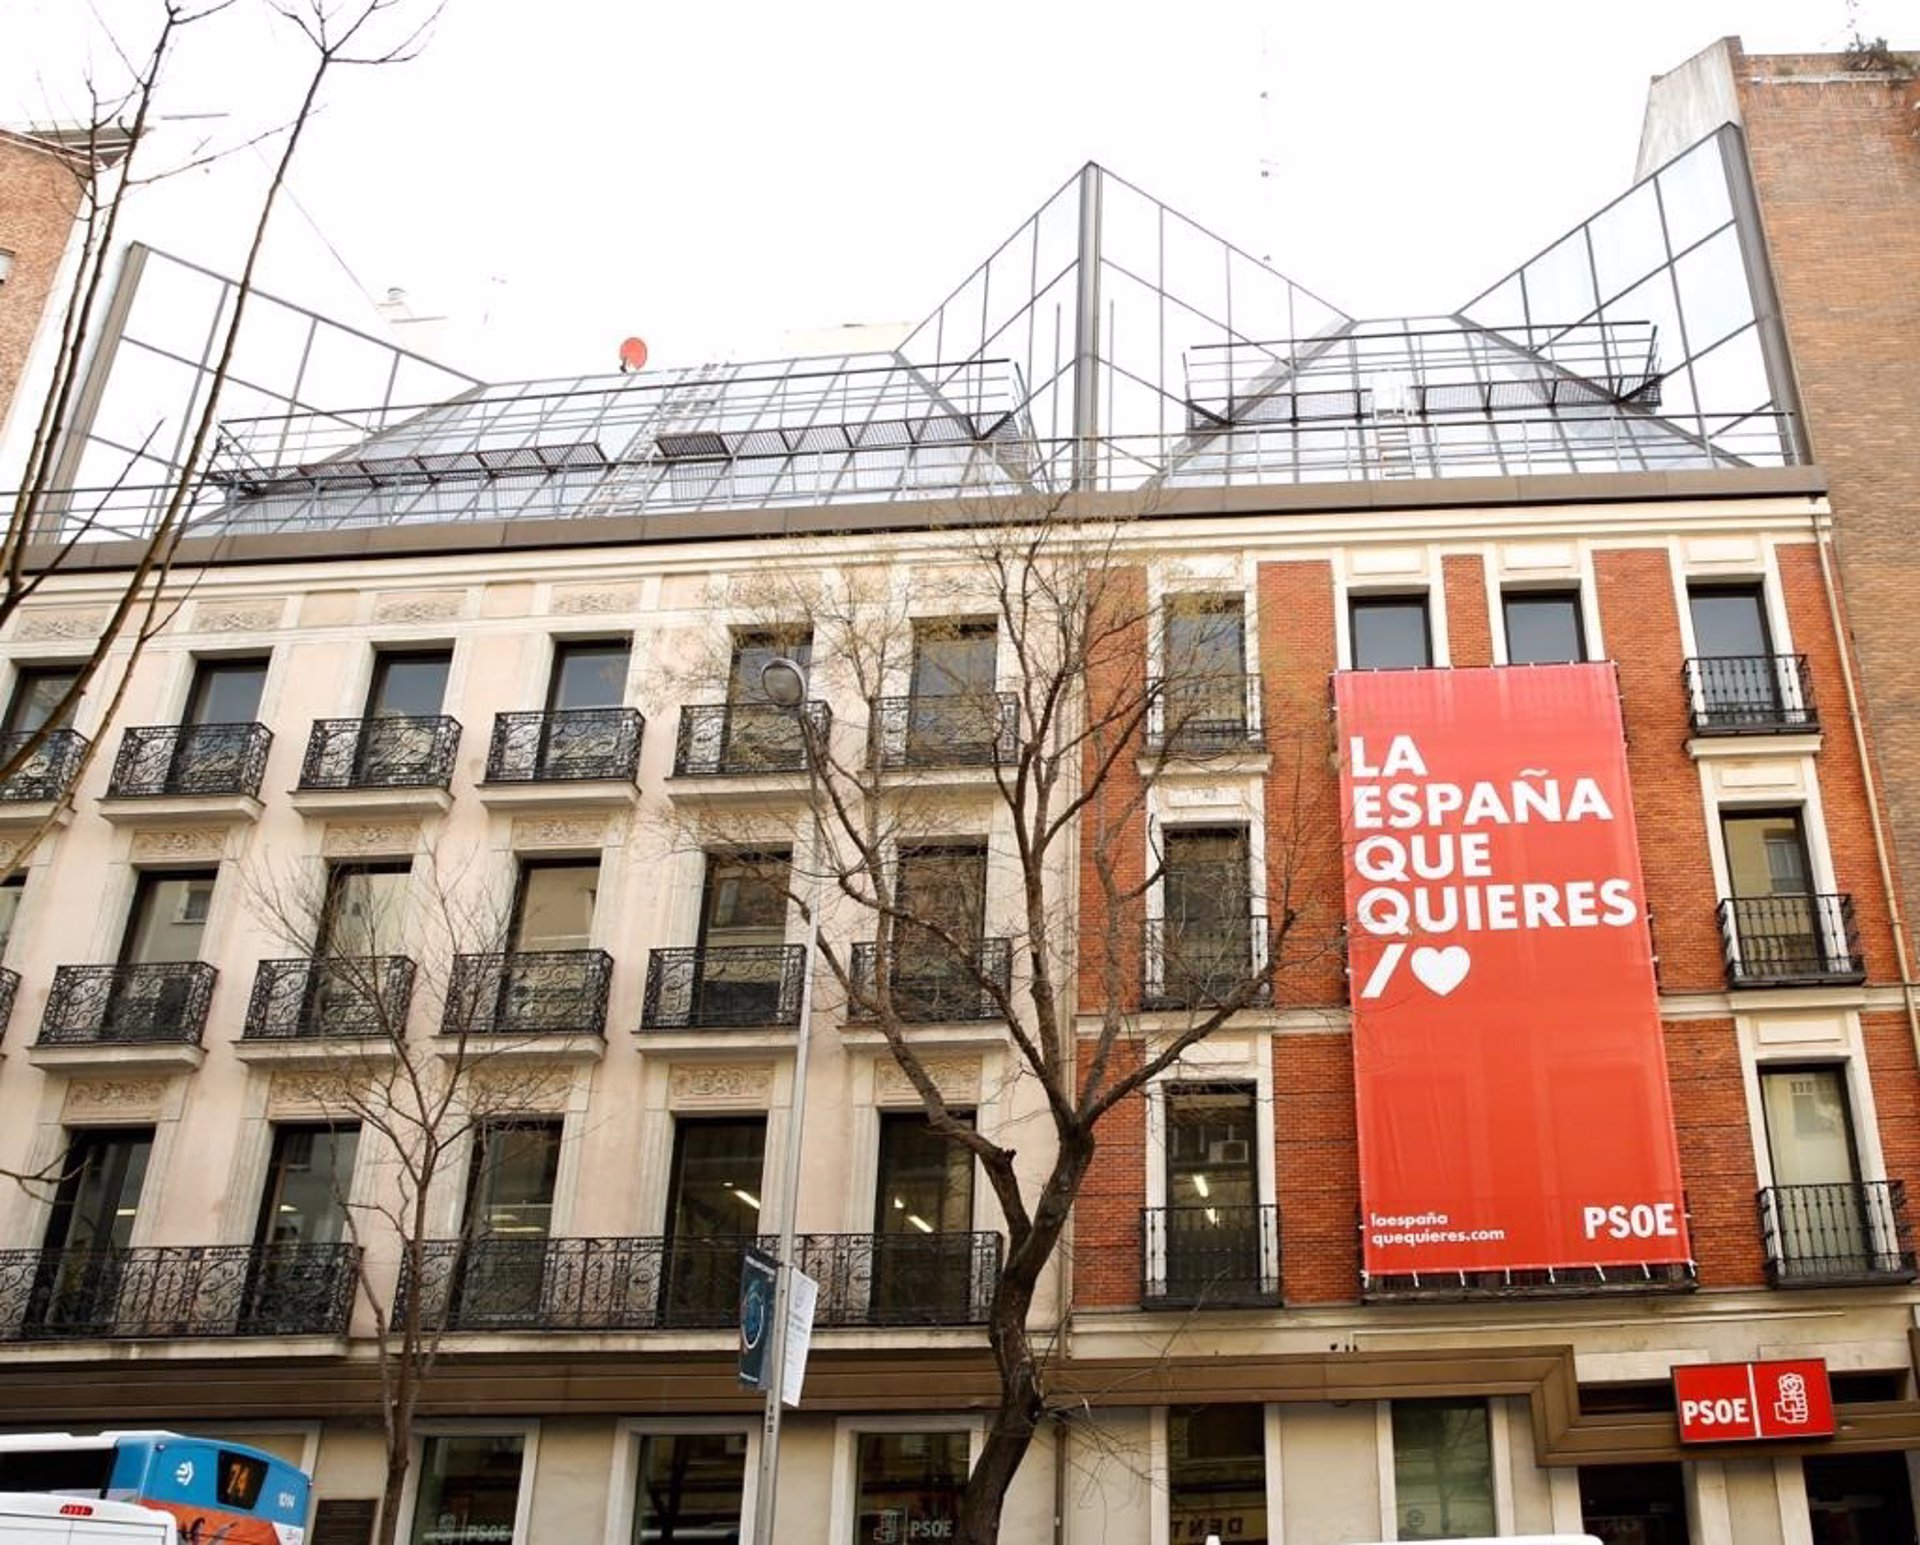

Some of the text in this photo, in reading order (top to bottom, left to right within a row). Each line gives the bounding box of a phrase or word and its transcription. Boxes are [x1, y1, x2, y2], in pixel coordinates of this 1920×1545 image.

[1350, 735, 1428, 778] LA
[1352, 768, 1614, 829] ESPAÑA
[1355, 832, 1493, 882] QUE
[1357, 879, 1638, 935] QUIERES
[1371, 1212, 1449, 1229] laespaña
[1372, 1228, 1505, 1247] quequieres.com
[1584, 1203, 1679, 1239] PSOE
[1682, 1398, 1750, 1426] PSOE
[910, 1519, 954, 1538] PSOE
